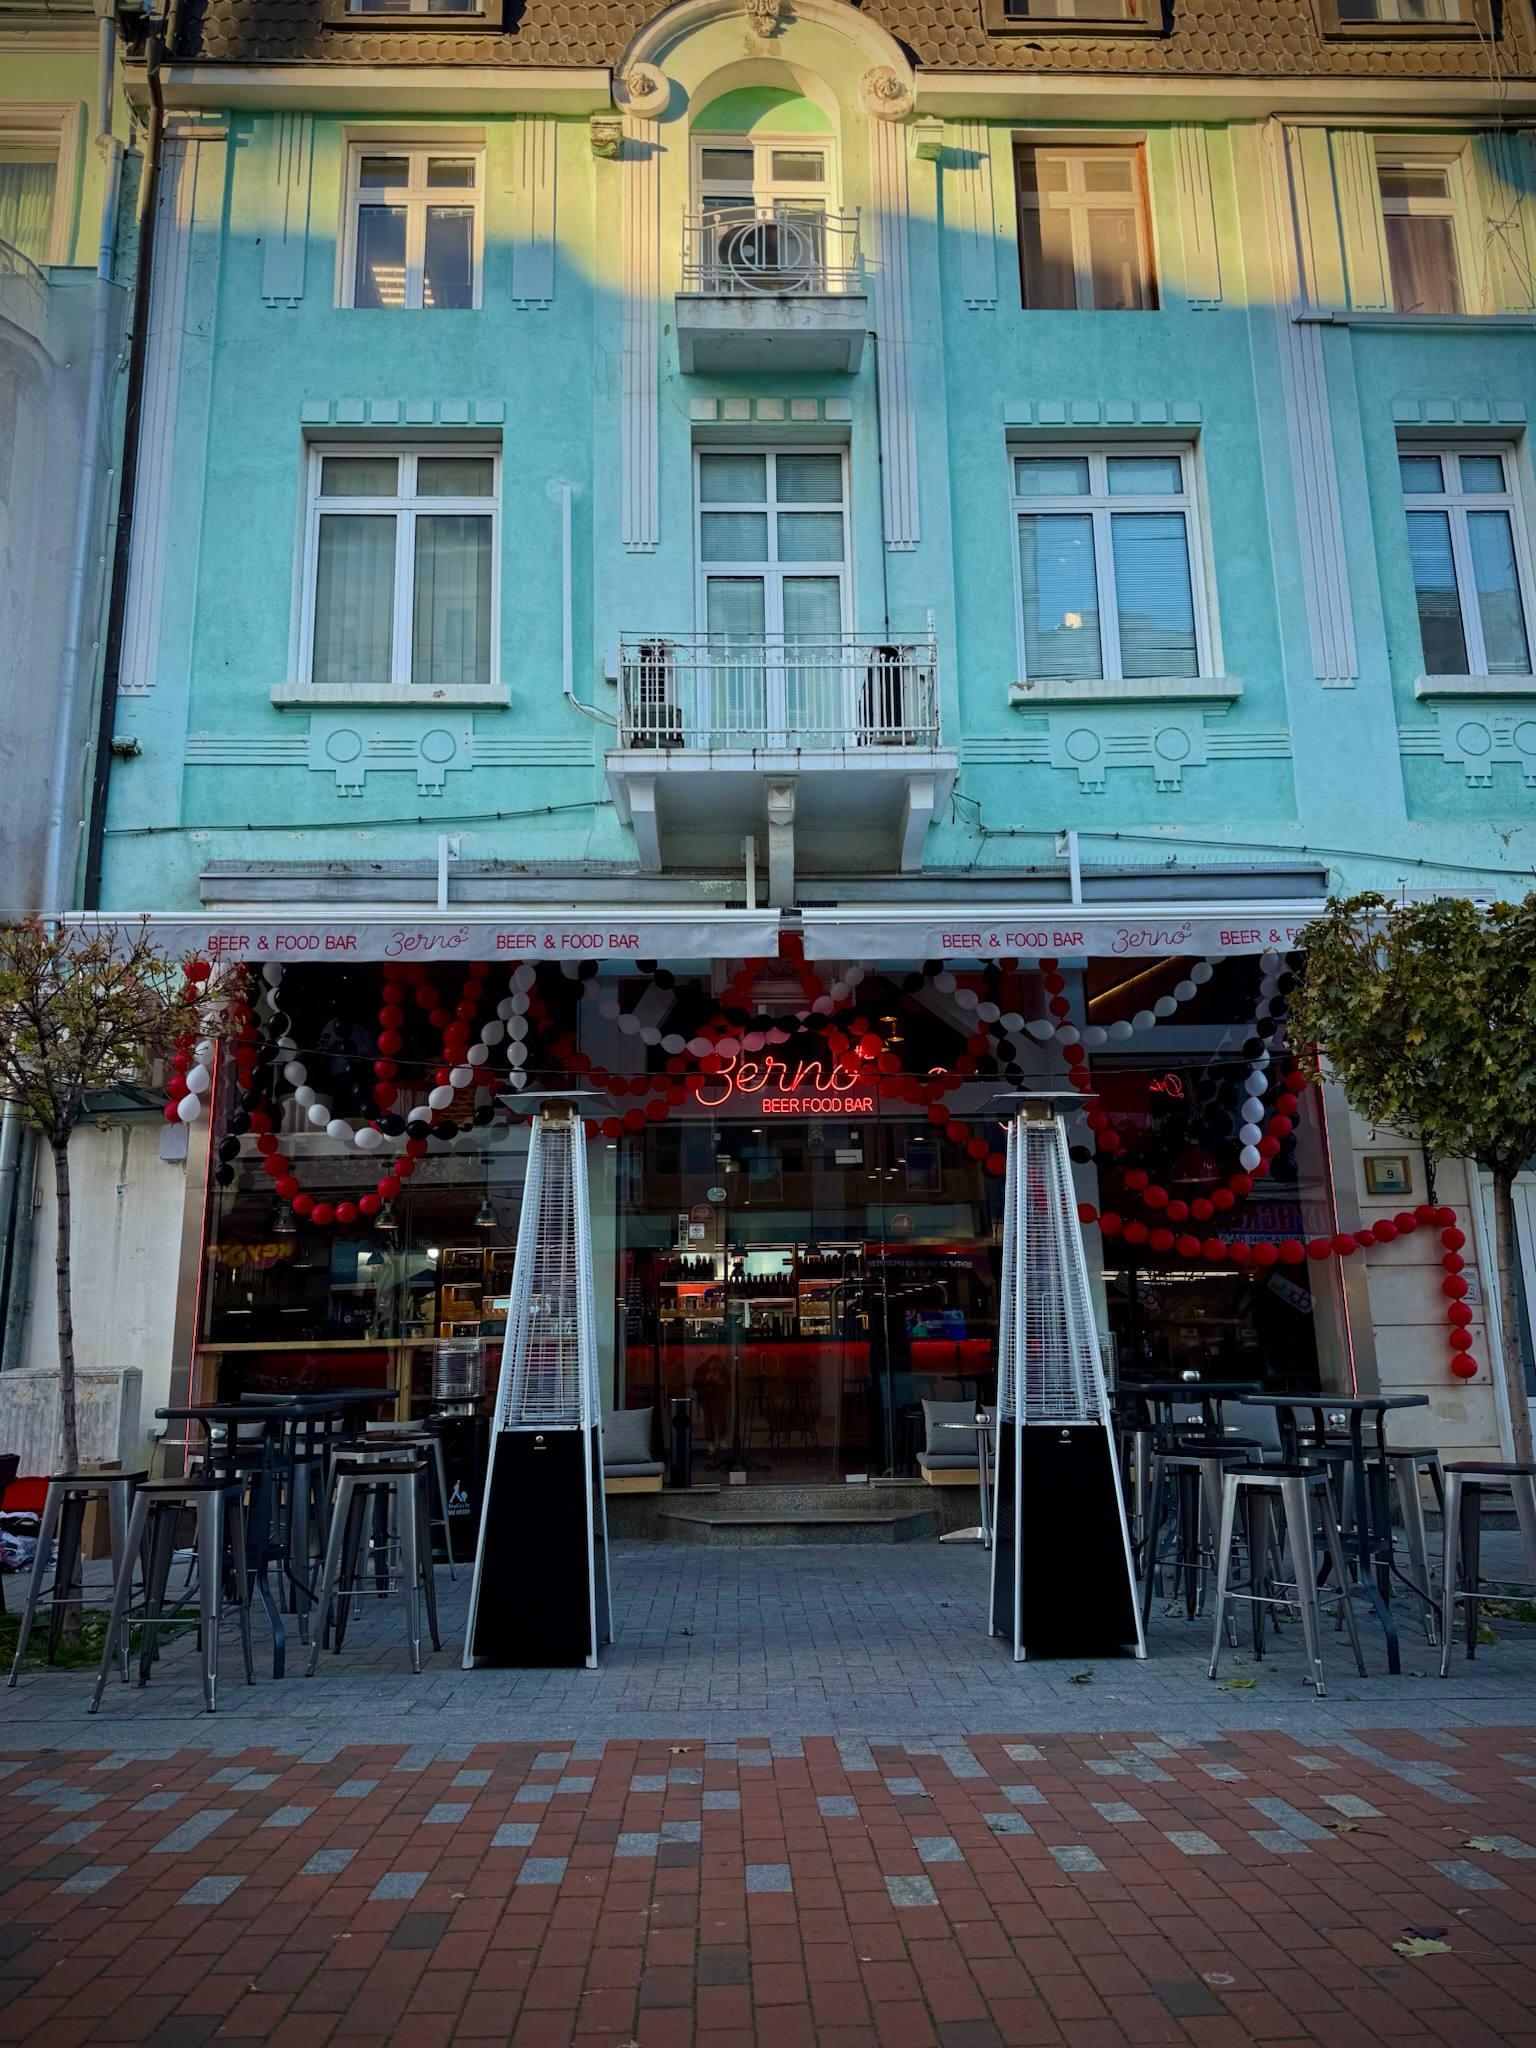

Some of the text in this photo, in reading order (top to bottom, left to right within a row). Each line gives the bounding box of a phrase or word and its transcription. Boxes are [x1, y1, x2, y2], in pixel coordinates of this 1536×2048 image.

[207, 935, 358, 951] BEER & FOOD BAR
[496, 934, 640, 949] BEER & FOOD BAR
[942, 932, 1084, 948] BEER & FOOD BAR
[1220, 929, 1263, 946] BEER
[1269, 928, 1282, 943] &
[762, 1097, 874, 1113] BEER FOOD BAR
[1386, 1169, 1394, 1179] 9
